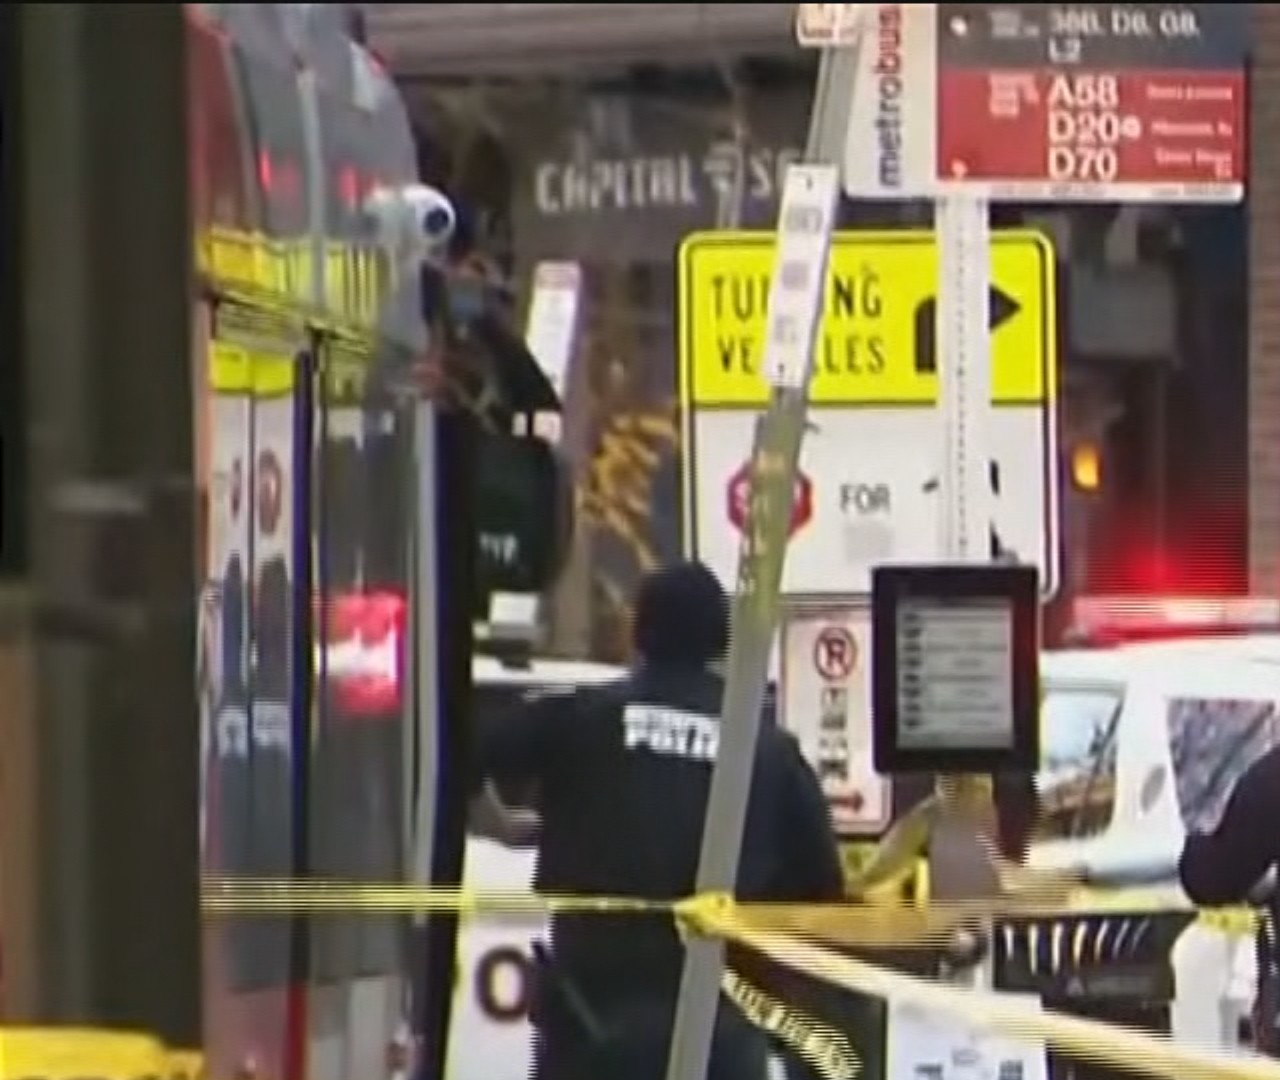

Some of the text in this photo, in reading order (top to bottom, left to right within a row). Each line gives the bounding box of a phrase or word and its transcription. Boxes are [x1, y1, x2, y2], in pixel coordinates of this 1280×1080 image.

[873, 8, 902, 187] metrobus
[1048, 74, 1119, 107] A58
[1048, 110, 1120, 143] D20
[1048, 146, 1119, 180] D70
[535, 153, 698, 215] CAPITAL
[839, 483, 891, 513] FOR
